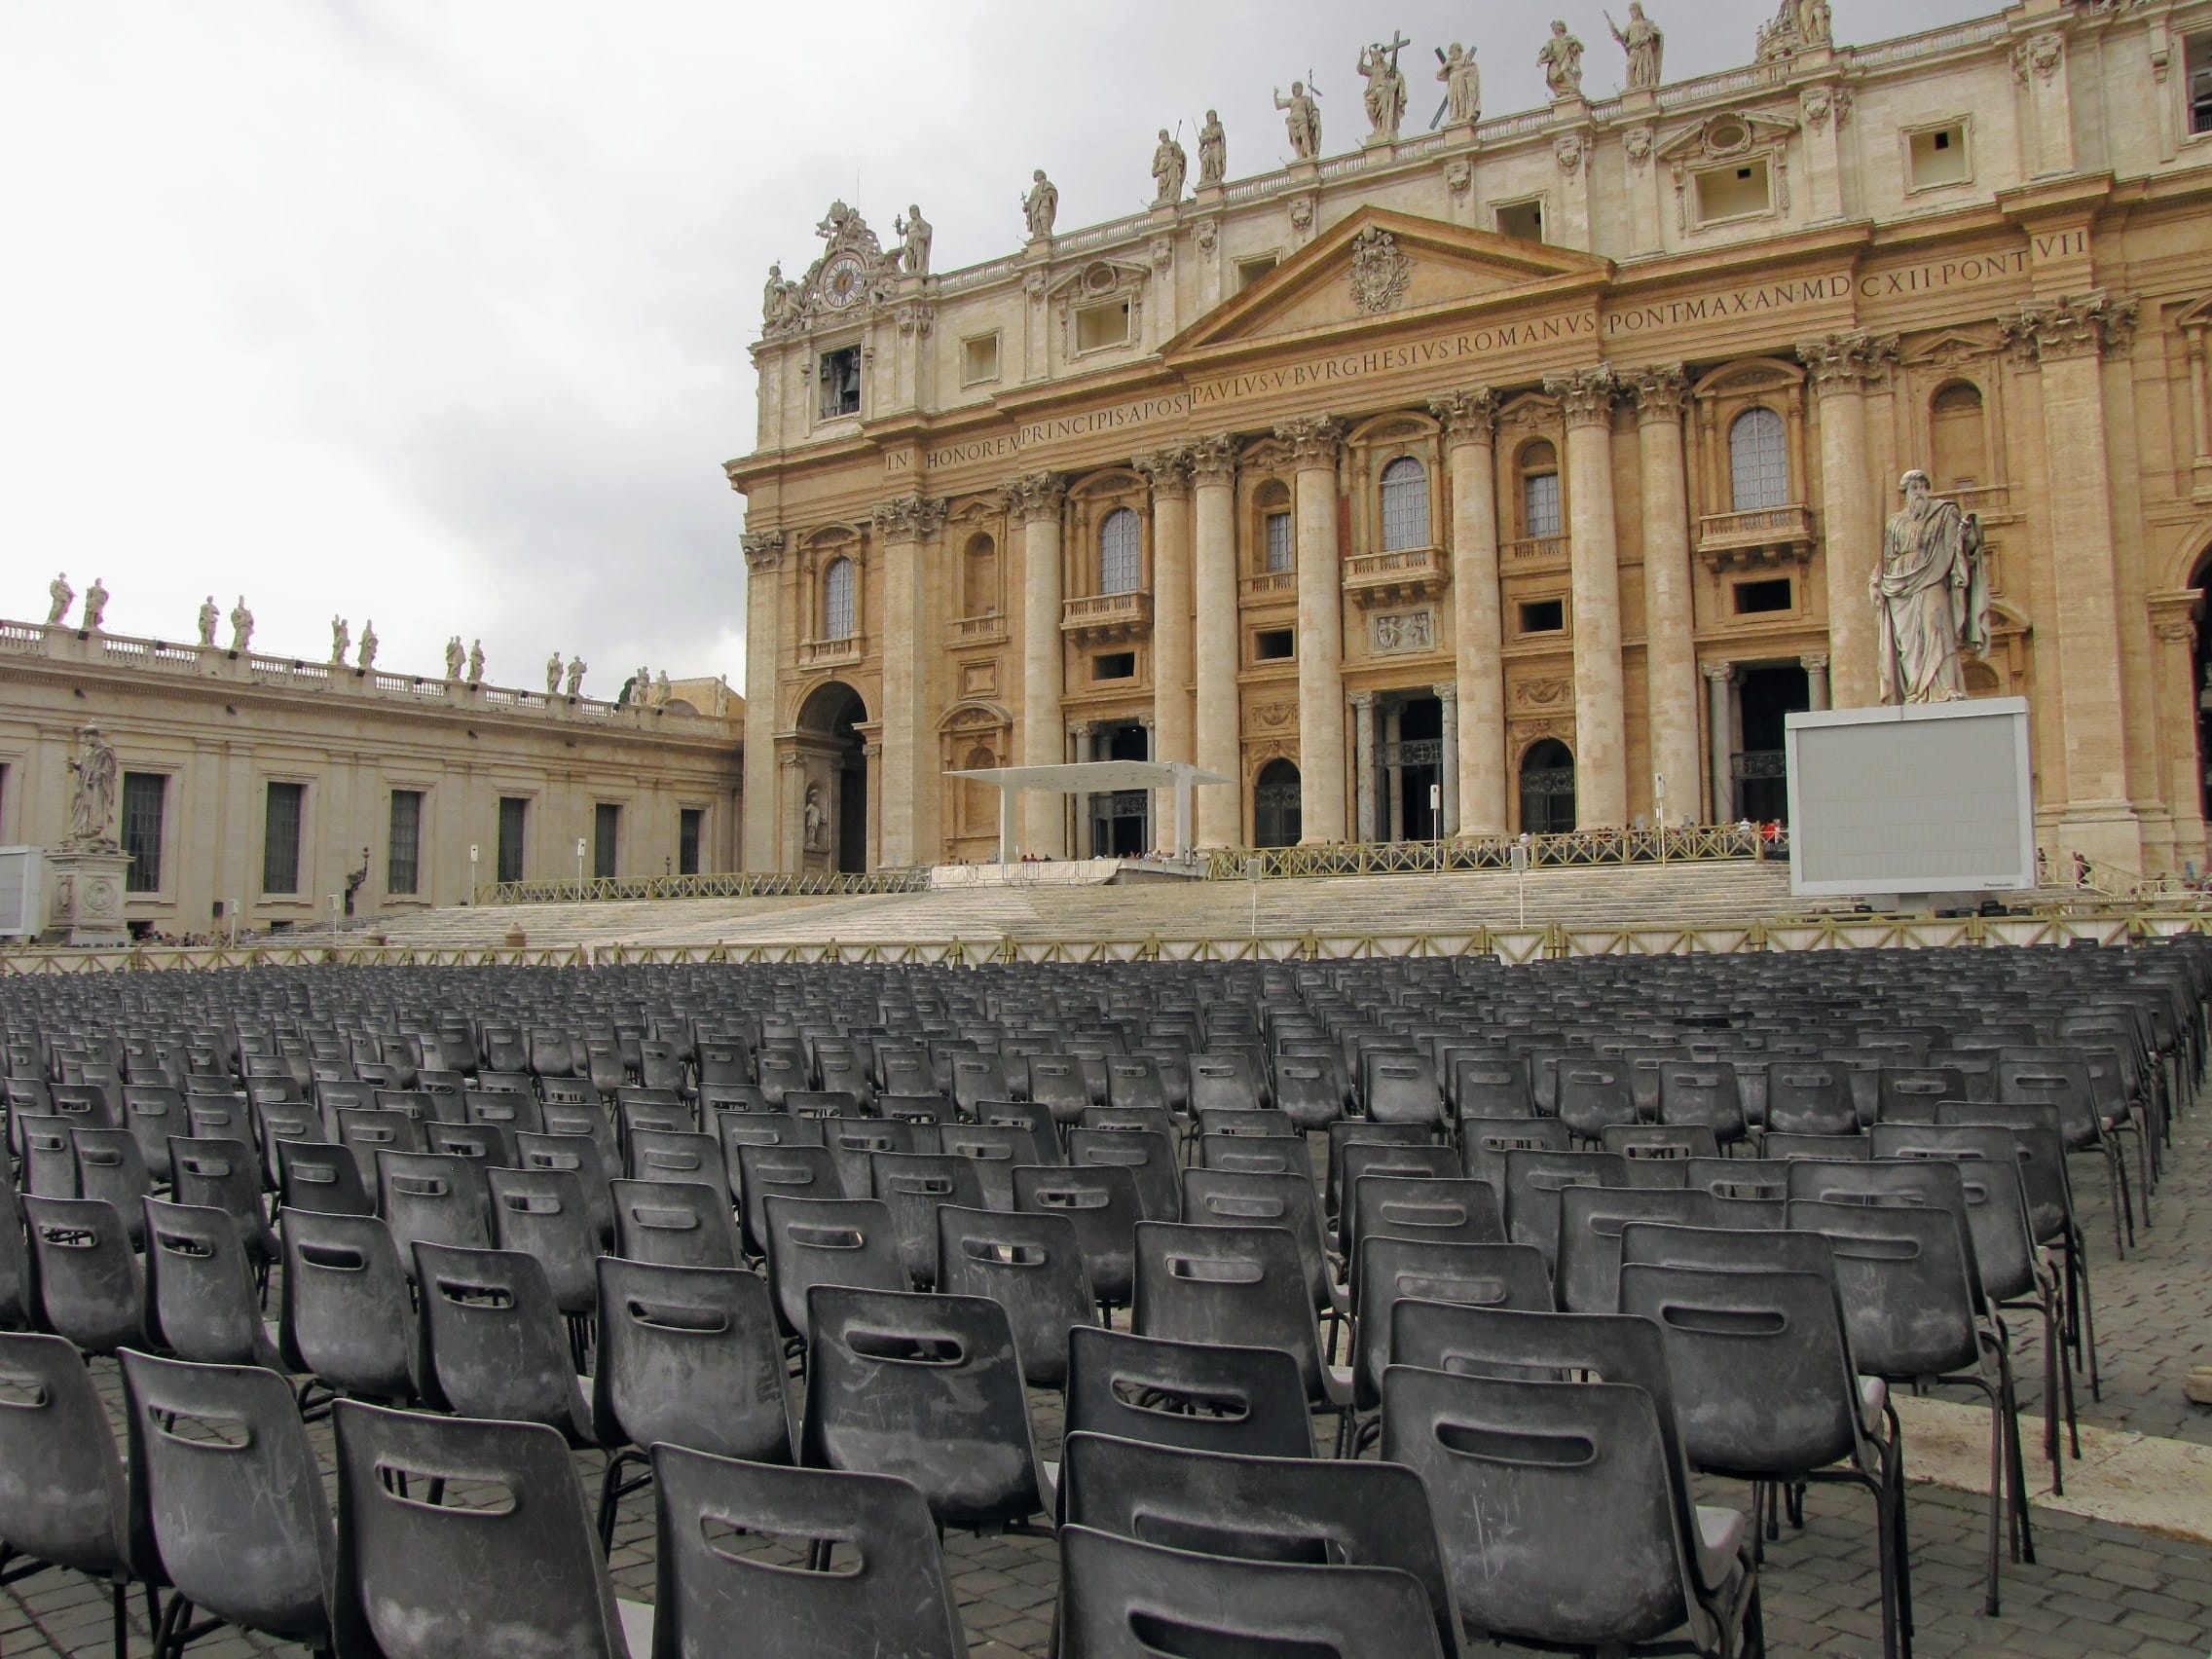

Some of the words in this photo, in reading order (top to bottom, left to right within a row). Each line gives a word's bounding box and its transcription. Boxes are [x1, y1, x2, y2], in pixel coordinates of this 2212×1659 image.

[887, 452, 908, 471] IN
[926, 435, 1020, 469] HONOREM
[1021, 408, 1124, 444] PRINCIPIS
[1193, 374, 1269, 404] PAVLVS
[1274, 371, 1287, 387] V
[1295, 341, 1448, 385] BVRGHESIVS
[1457, 313, 1594, 355] ROMANVS
[1609, 304, 1681, 334] PONT
[1685, 293, 1750, 319] MAX
[1754, 284, 1793, 310] AN
[1942, 250, 2027, 284] PONT
[2036, 231, 2085, 258] VII
